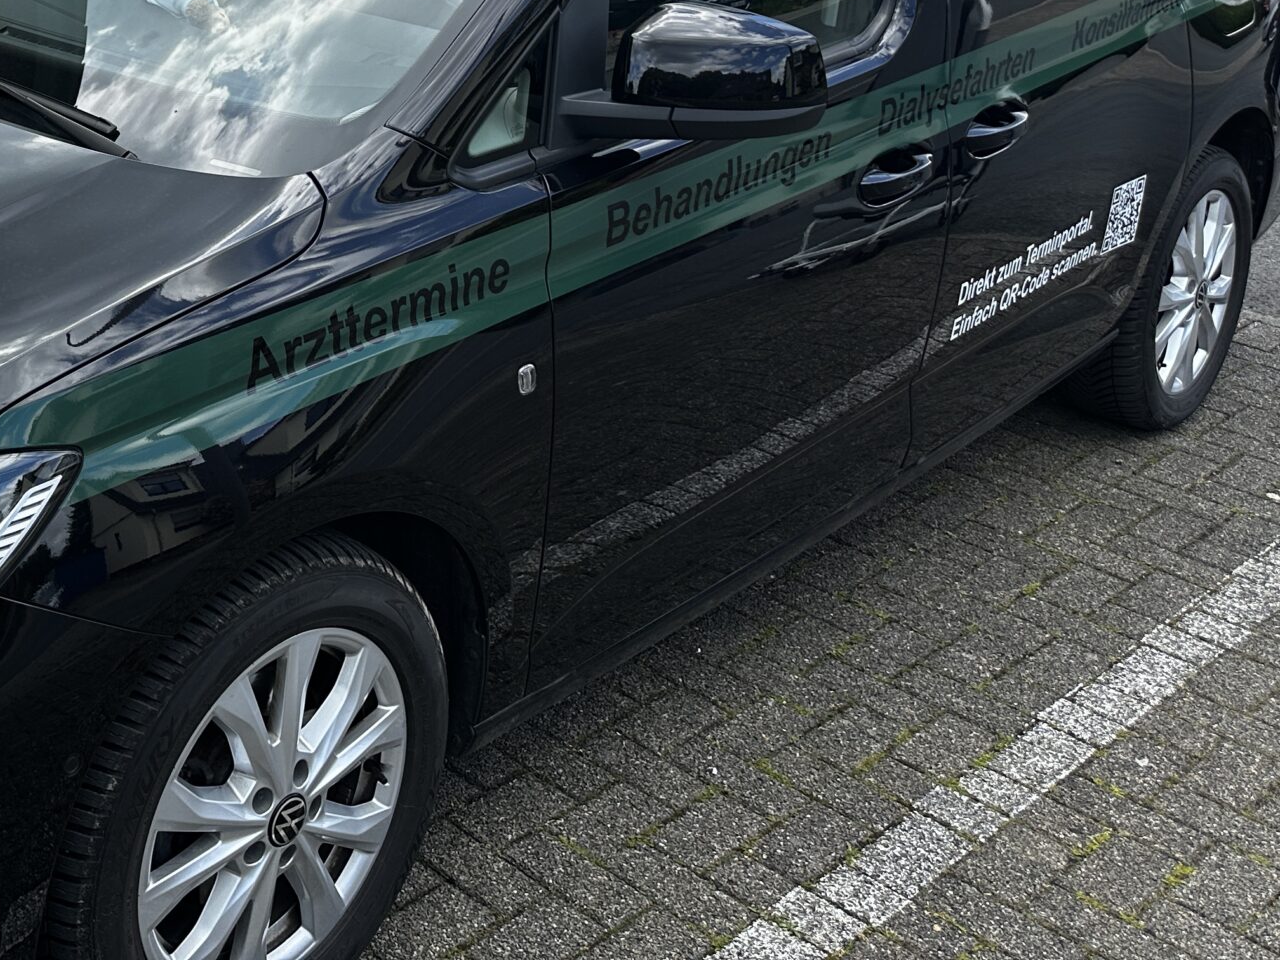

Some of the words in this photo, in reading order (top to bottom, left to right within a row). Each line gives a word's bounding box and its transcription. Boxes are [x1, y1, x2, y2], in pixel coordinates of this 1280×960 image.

[877, 46, 1036, 137] Dialysefahrten
[605, 131, 833, 249] Behandlungen
[949, 296, 998, 342] Einfach
[999, 266, 1051, 312] QR-Code
[1050, 241, 1098, 281] scannen.
[957, 266, 997, 307] Direkt
[996, 255, 1023, 284] zum
[1025, 210, 1094, 267] Terminportal.
[245, 257, 511, 398] Arzttermine
